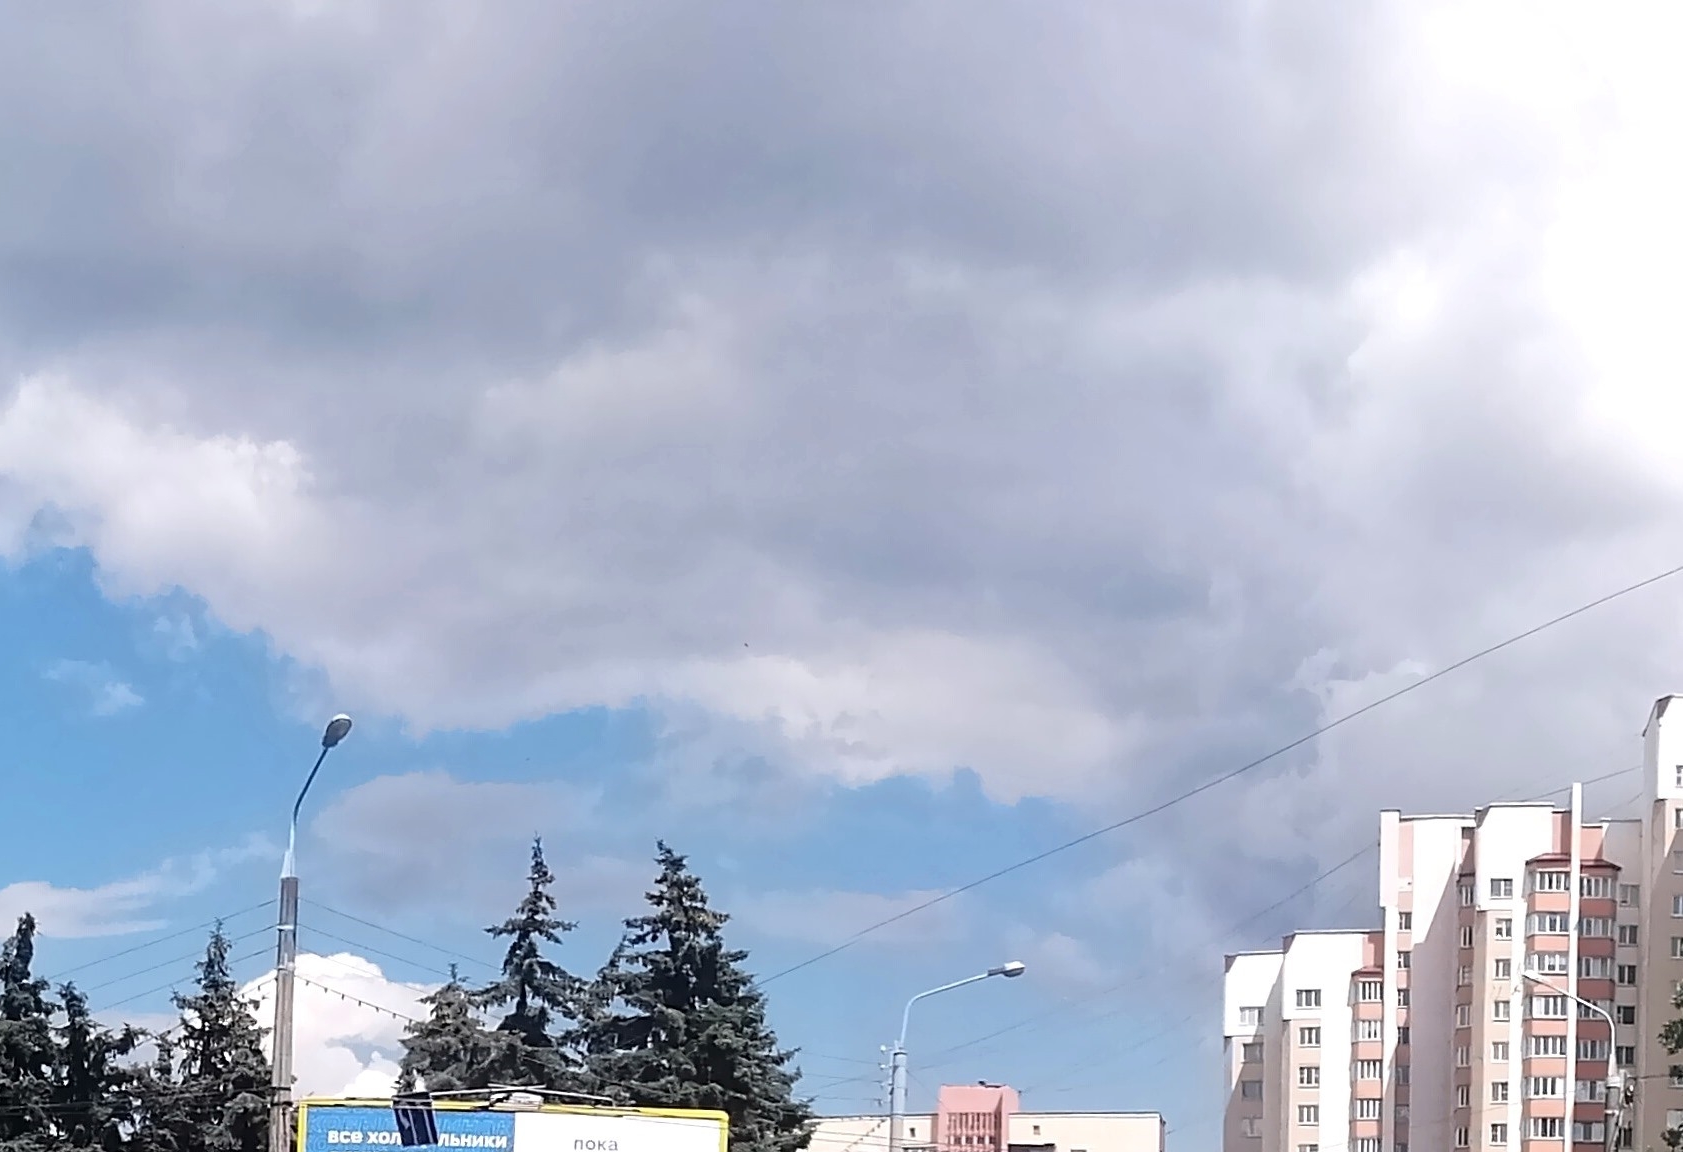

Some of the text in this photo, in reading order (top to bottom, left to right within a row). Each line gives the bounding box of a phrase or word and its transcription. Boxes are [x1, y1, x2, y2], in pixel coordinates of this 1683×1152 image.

[327, 1129, 508, 1149] все холльники
[573, 1138, 619, 1152] пока
